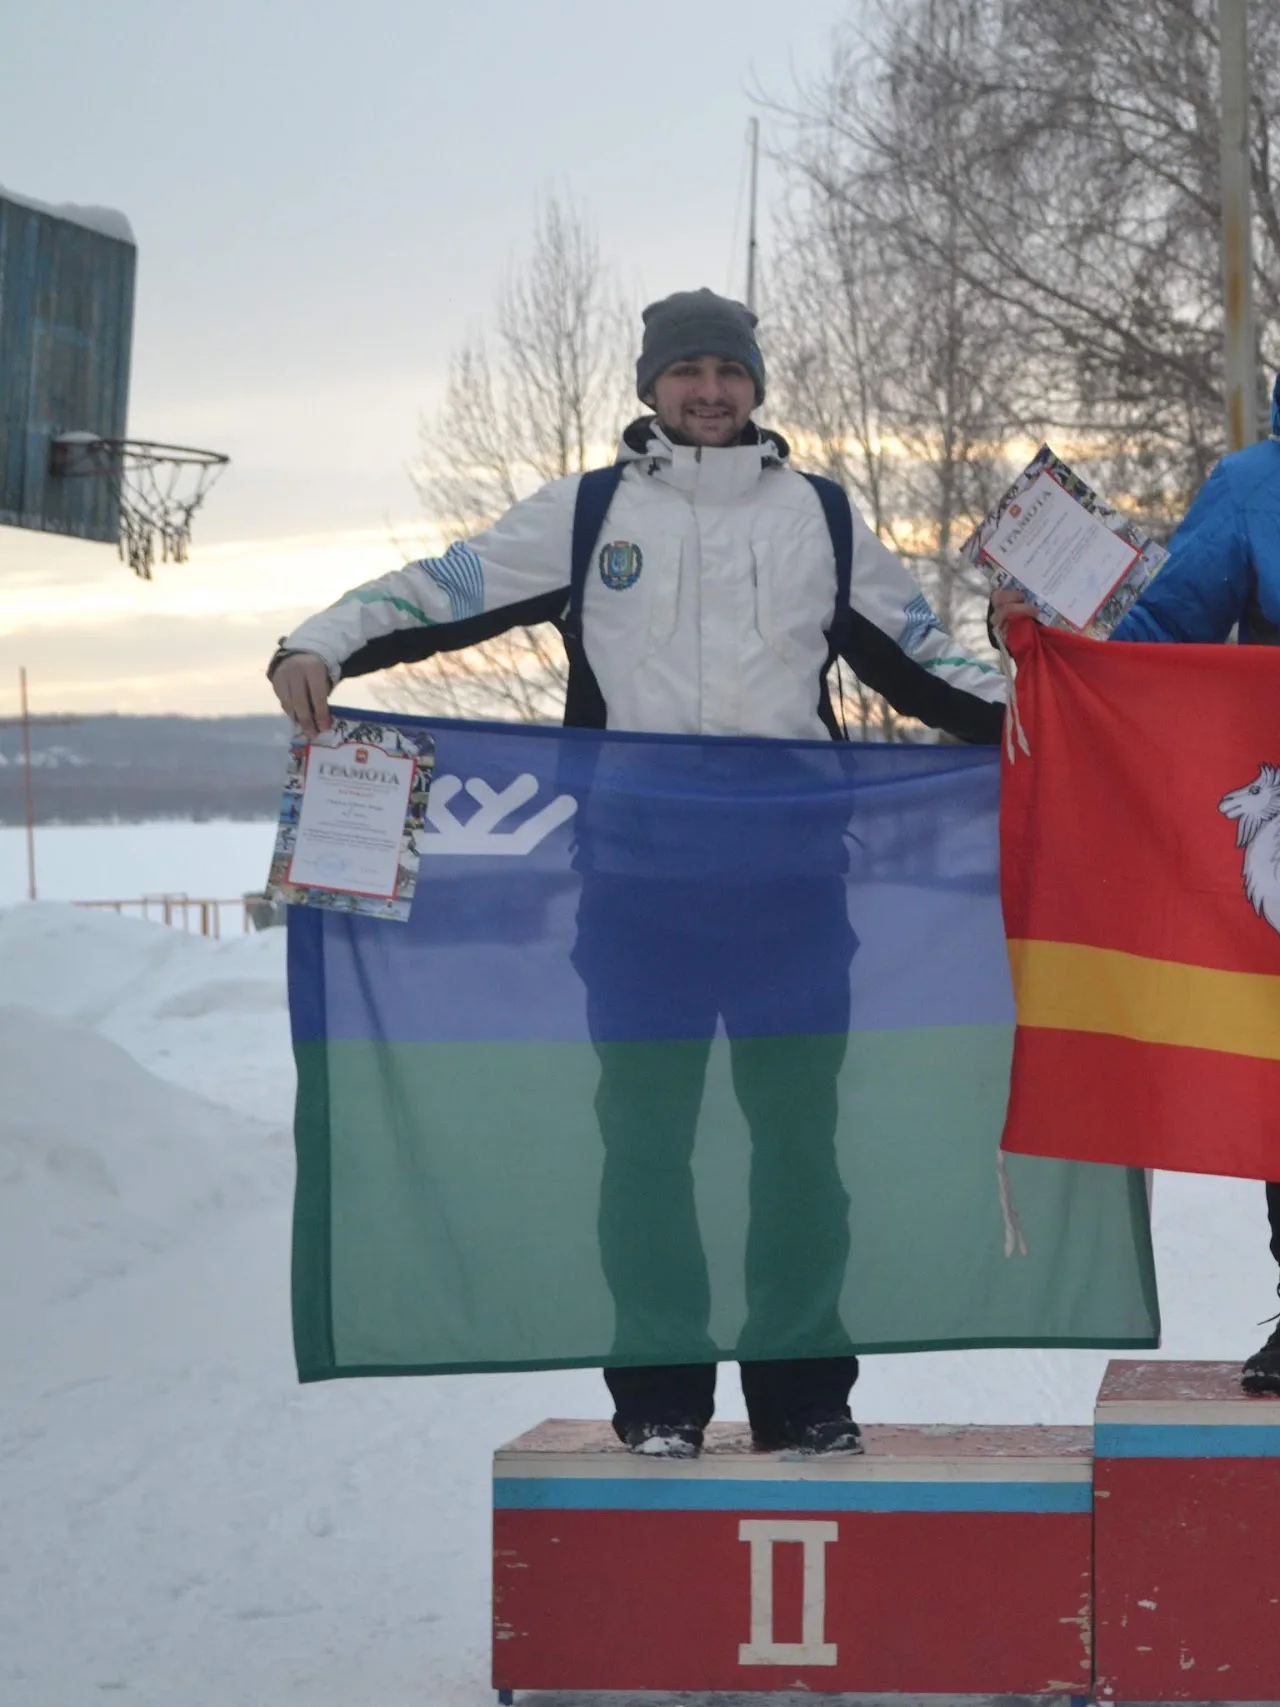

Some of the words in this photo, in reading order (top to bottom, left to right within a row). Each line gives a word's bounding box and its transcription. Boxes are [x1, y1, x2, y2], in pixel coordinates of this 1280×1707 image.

[1000, 490, 1052, 554] ГРАМОТА
[318, 762, 401, 786] ГРАМОТА
[738, 1519, 839, 1666] II
